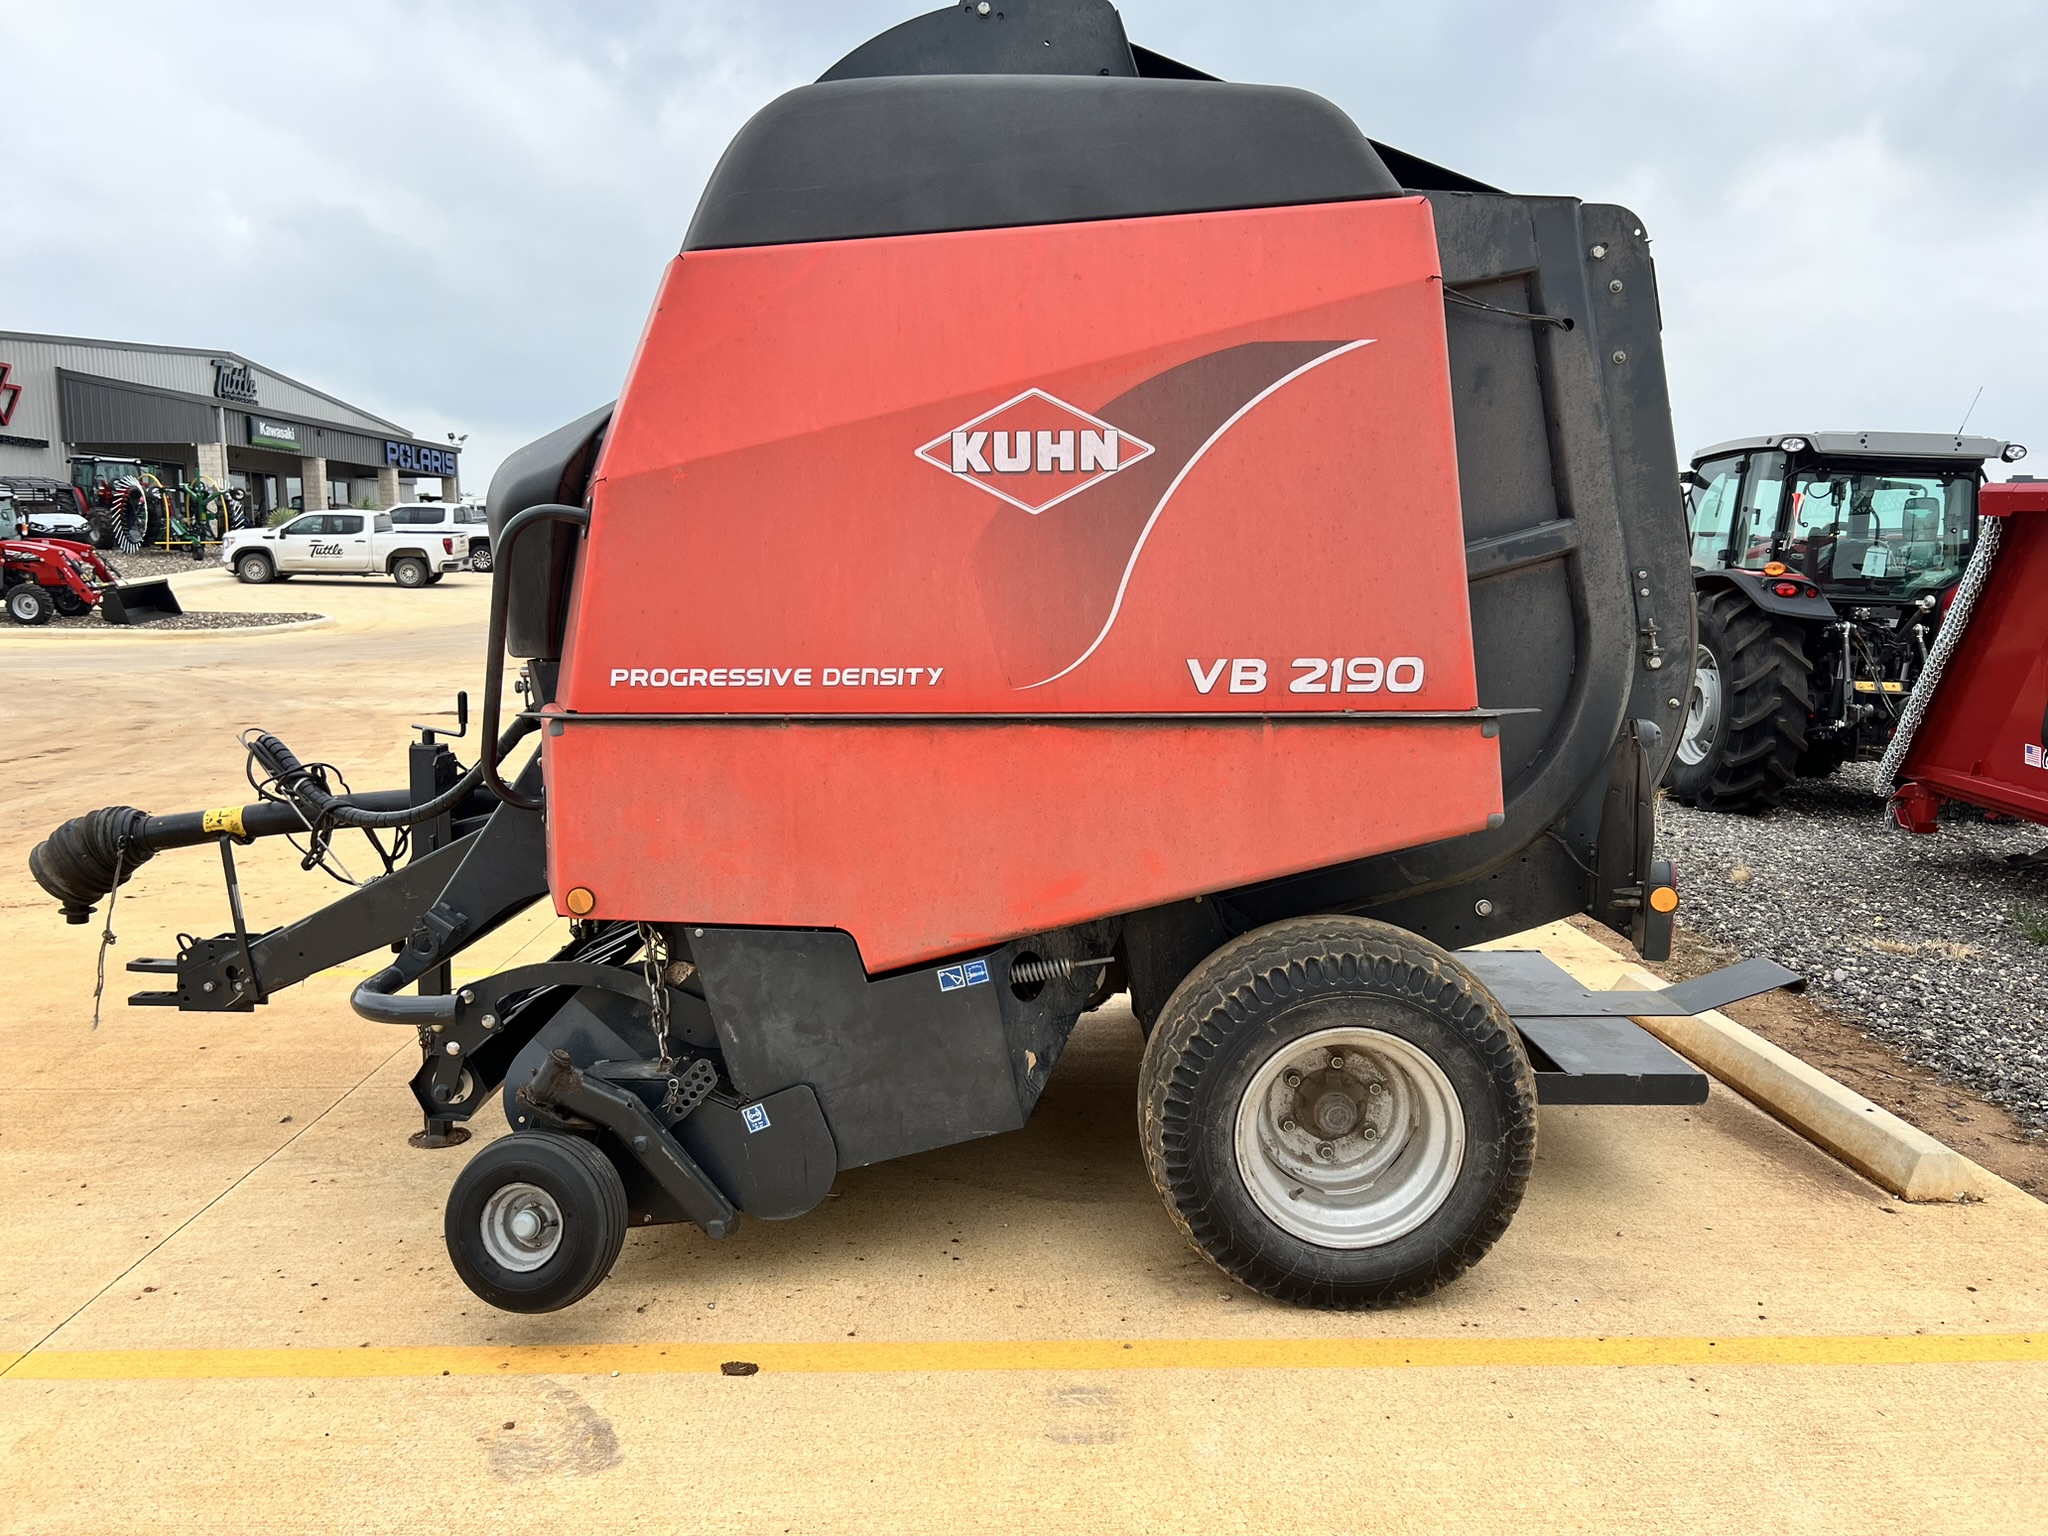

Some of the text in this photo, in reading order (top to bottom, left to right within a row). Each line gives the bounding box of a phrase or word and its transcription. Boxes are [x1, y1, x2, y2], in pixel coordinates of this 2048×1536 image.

[211, 359, 257, 398] Tuttle
[260, 422, 295, 440] Kawasaki
[385, 441, 456, 475] POLARIS
[952, 430, 1118, 473] KUHN
[309, 543, 344, 558] Tuttle
[610, 667, 944, 687] PROGRESSIVE DENSITY
[1186, 656, 1424, 694] VB 2190
